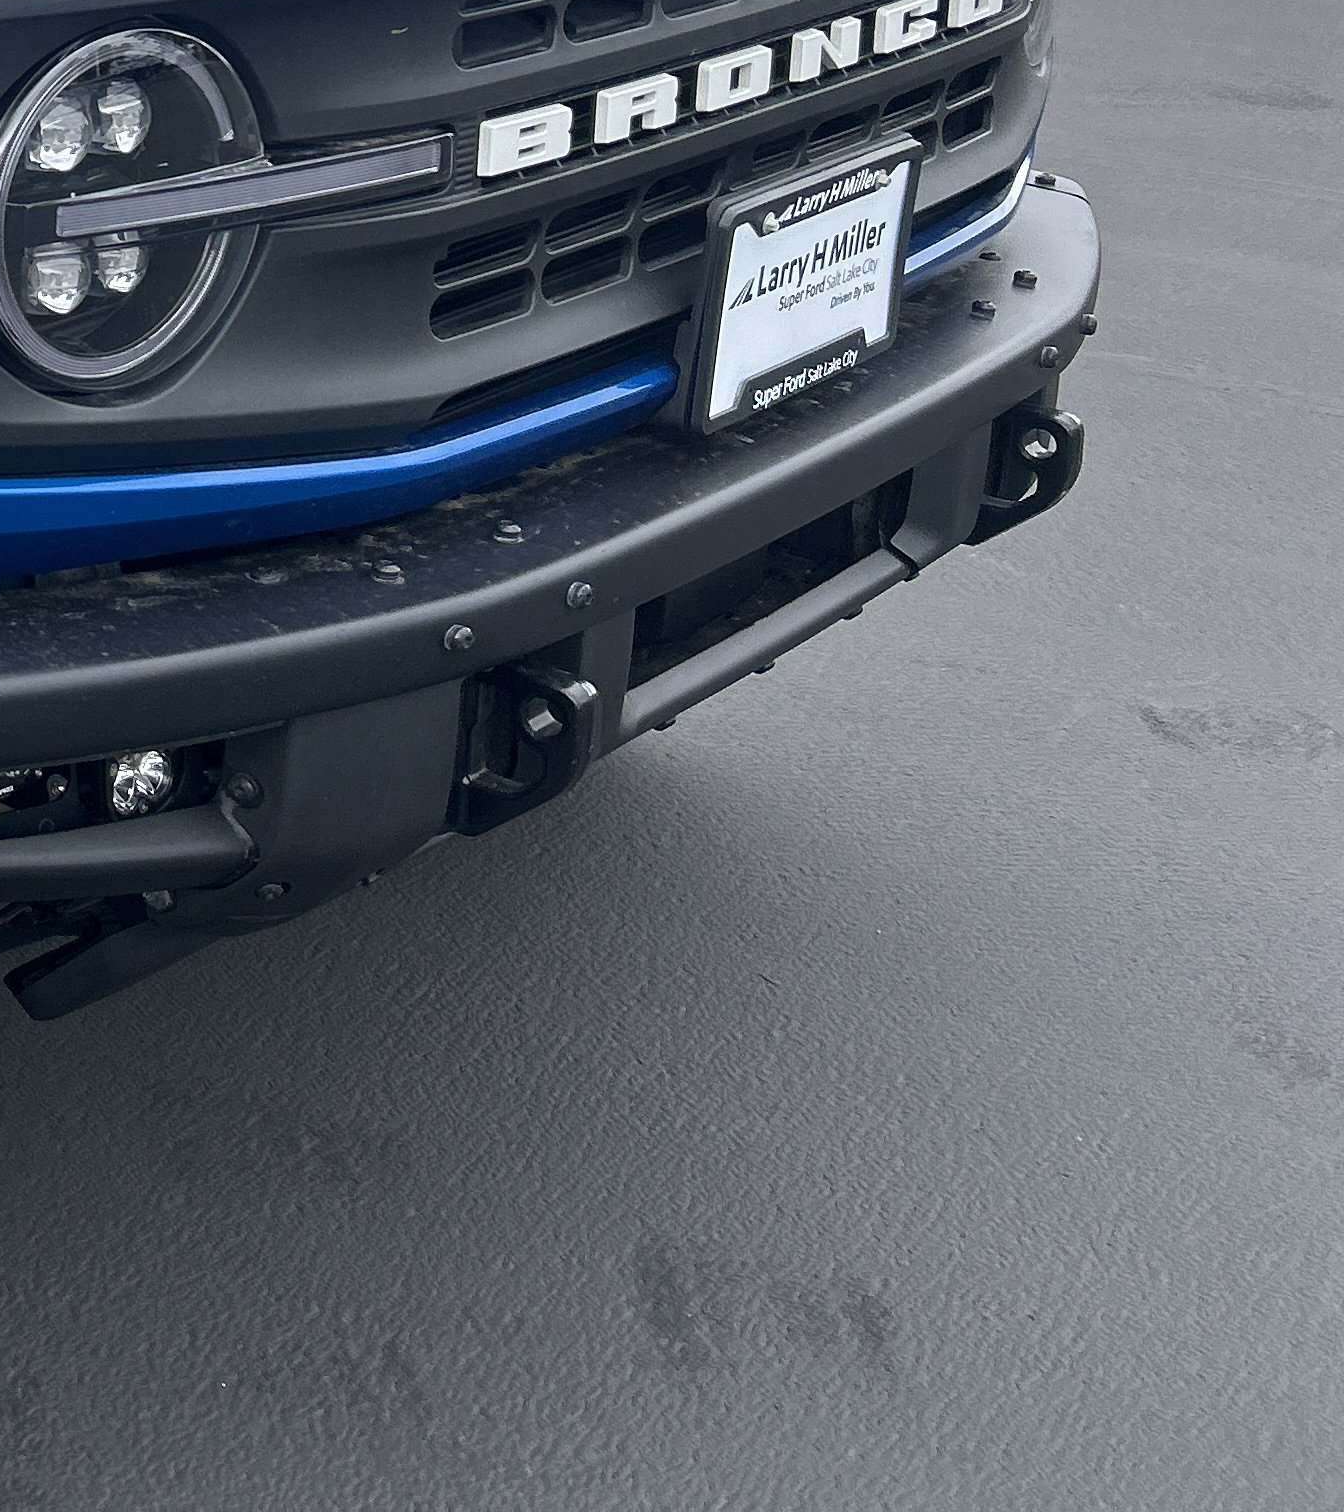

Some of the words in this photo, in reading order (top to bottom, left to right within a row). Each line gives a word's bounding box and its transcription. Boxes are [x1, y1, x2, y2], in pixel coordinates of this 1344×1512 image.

[793, 190, 830, 217] Larry
[828, 181, 843, 203] H
[840, 168, 880, 199] Miller
[757, 253, 810, 297] Larry
[811, 239, 828, 274] H
[828, 219, 886, 266] Miller
[779, 290, 804, 311] Super
[805, 275, 826, 299] Ford
[826, 270, 842, 290] Salt
[842, 263, 861, 283] Lake
[863, 258, 880, 274] City
[830, 289, 853, 308] Driven
[753, 382, 783, 409] Super
[783, 368, 807, 395] Ford
[807, 364, 824, 384] Salt
[824, 357, 842, 376] Lake
[843, 349, 858, 367] City
